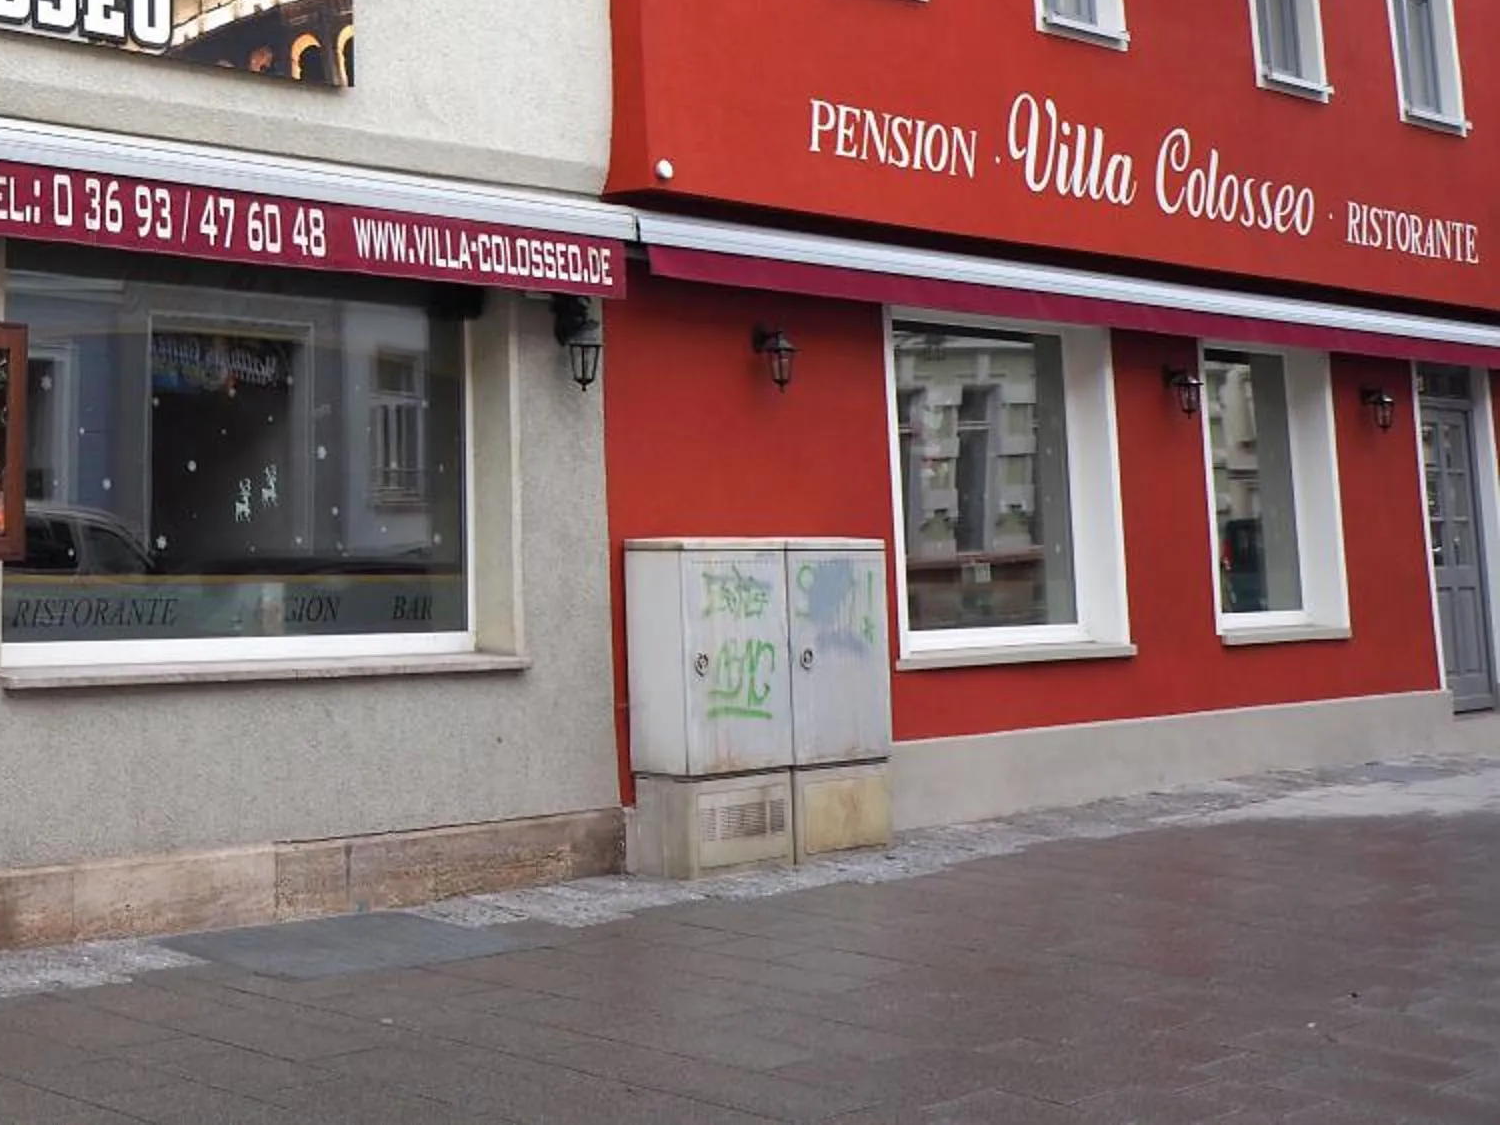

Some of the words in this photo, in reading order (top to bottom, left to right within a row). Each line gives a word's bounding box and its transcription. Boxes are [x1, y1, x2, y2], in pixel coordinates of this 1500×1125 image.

[85, 178, 123, 233] 36
[135, 185, 172, 239] 93
[199, 195, 235, 248] 47
[247, 201, 282, 254] 60
[292, 206, 326, 257] 48
[808, 98, 978, 178] PENSION
[1007, 92, 1138, 206] Villa
[1155, 127, 1315, 236] Colosseo
[1346, 200, 1479, 264] RISTORANTE
[11, 596, 181, 629] RISTORANTE
[392, 594, 434, 621] BAR
